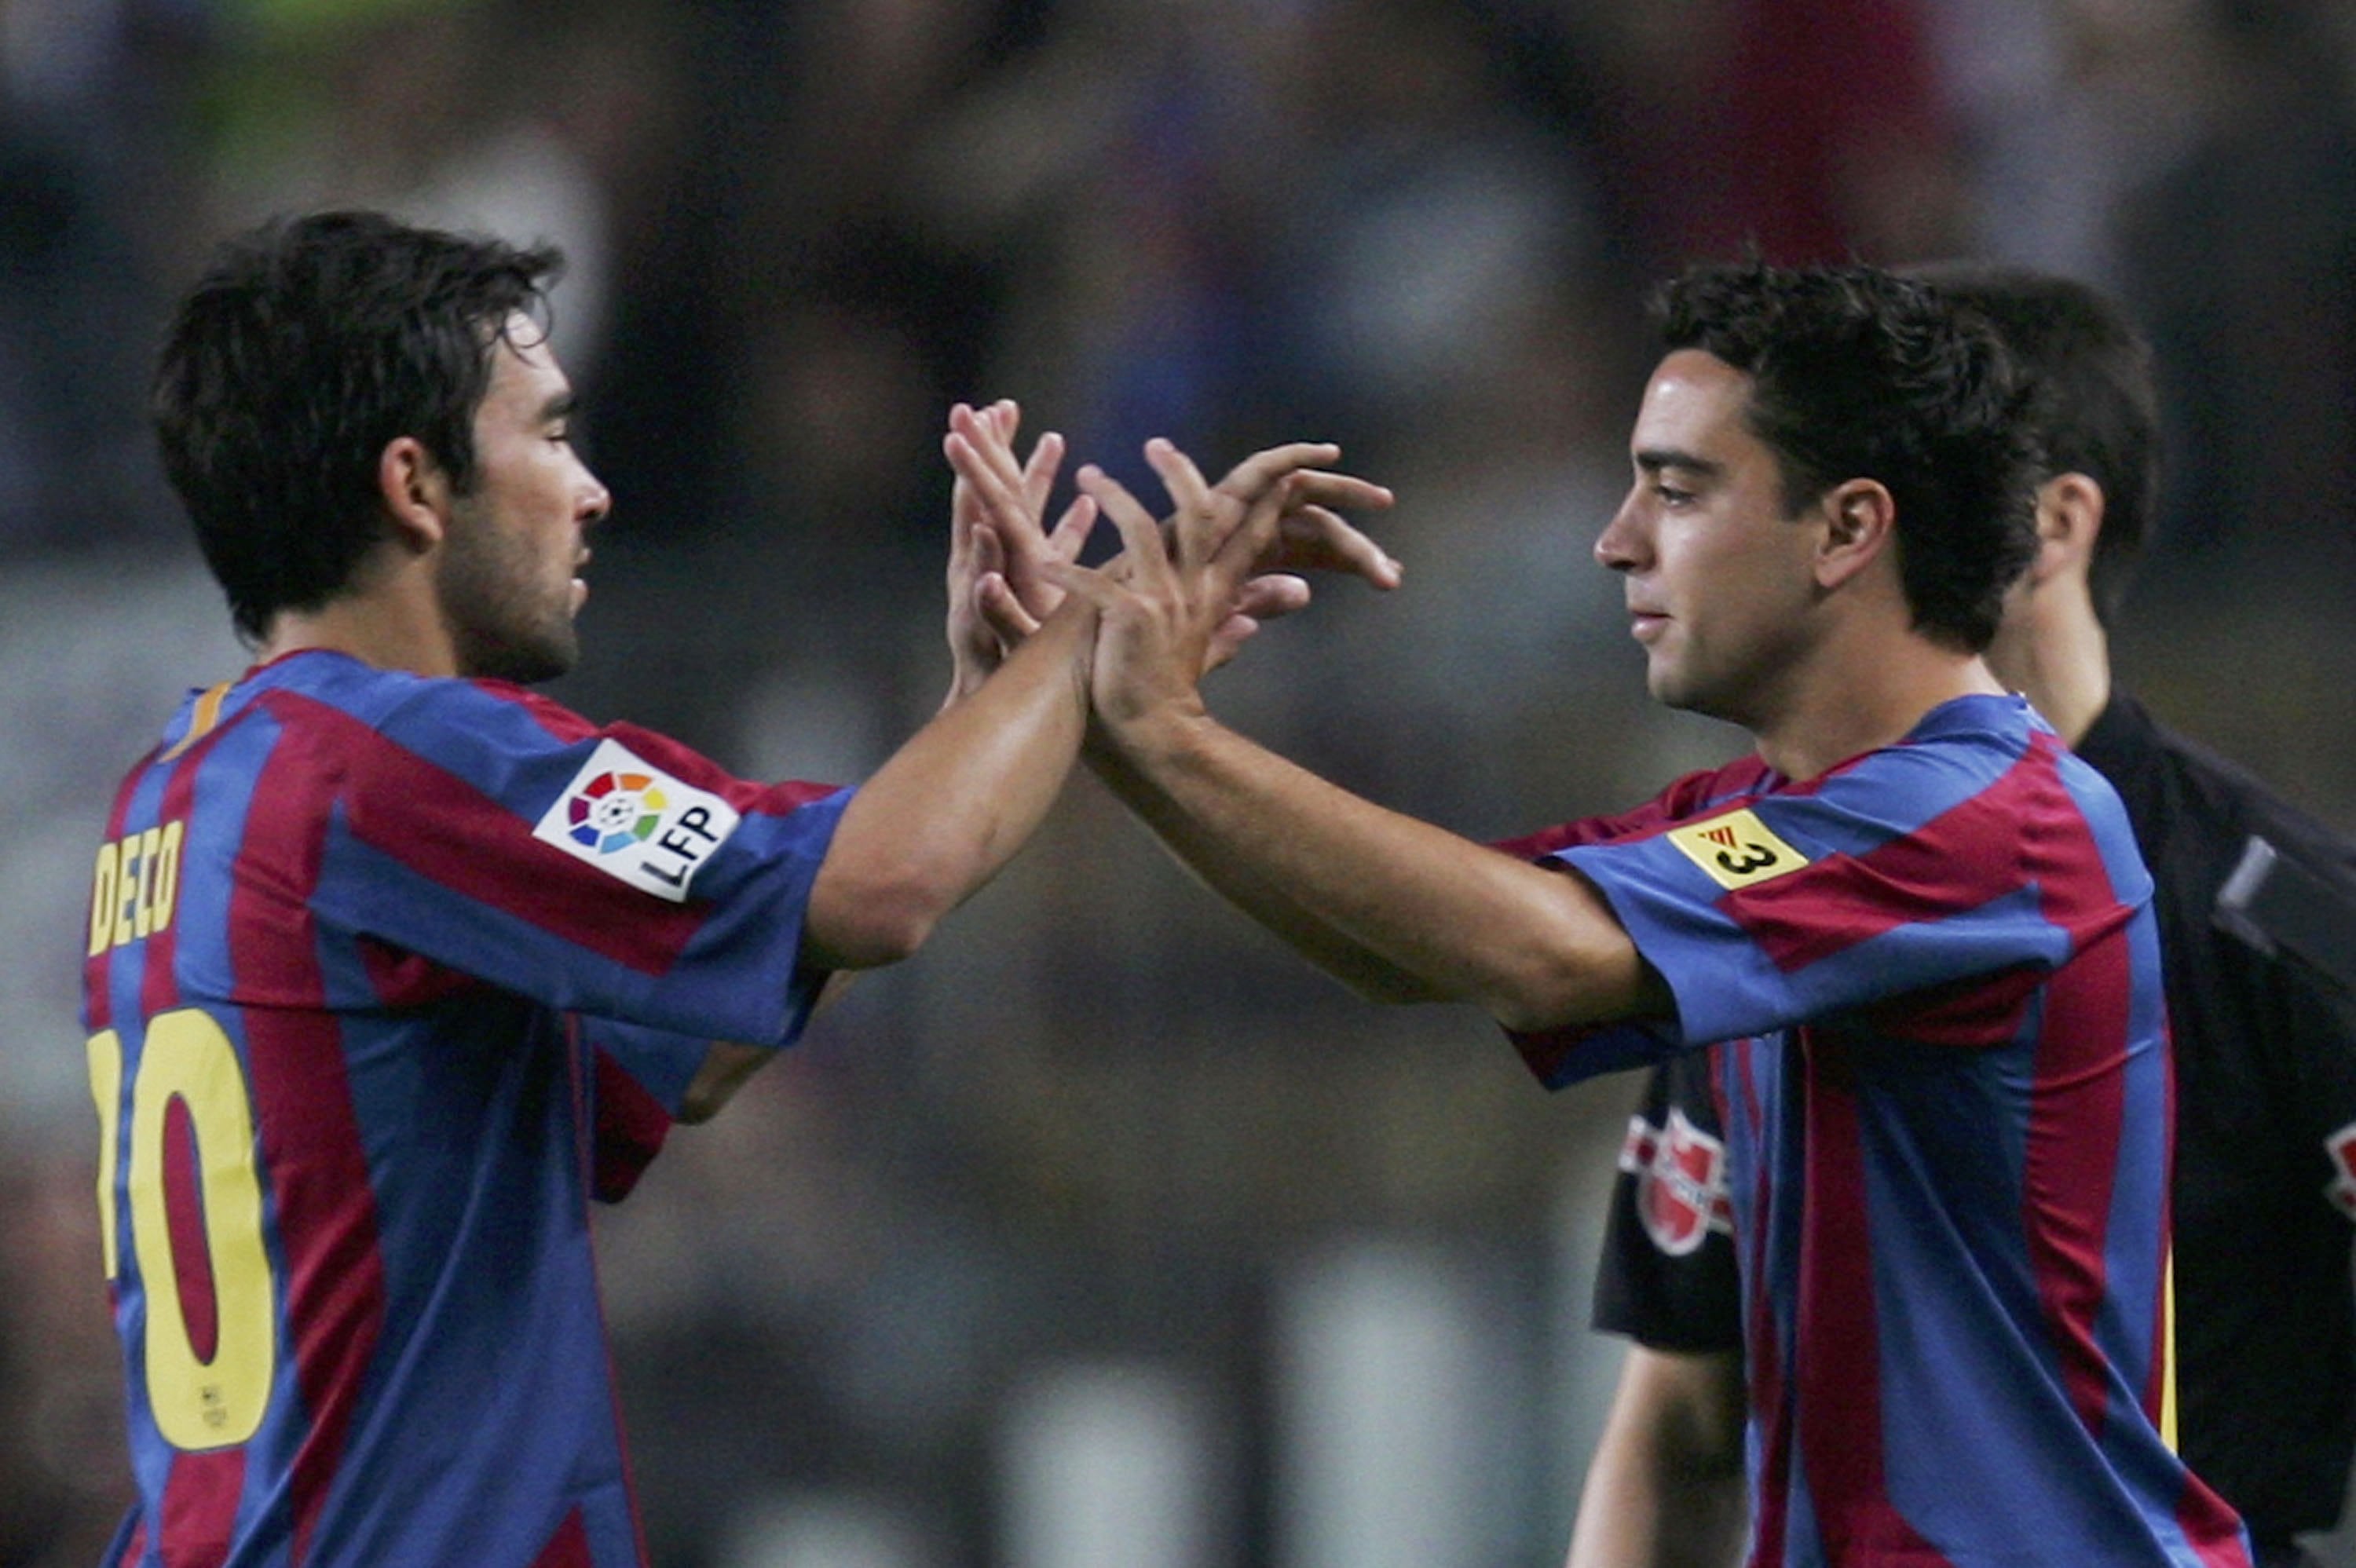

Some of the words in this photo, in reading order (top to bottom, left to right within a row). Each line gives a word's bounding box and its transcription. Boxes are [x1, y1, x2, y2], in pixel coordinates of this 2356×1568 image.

[640, 806, 719, 888] LFP
[1716, 842, 1778, 875] 3
[88, 820, 184, 957] DECO
